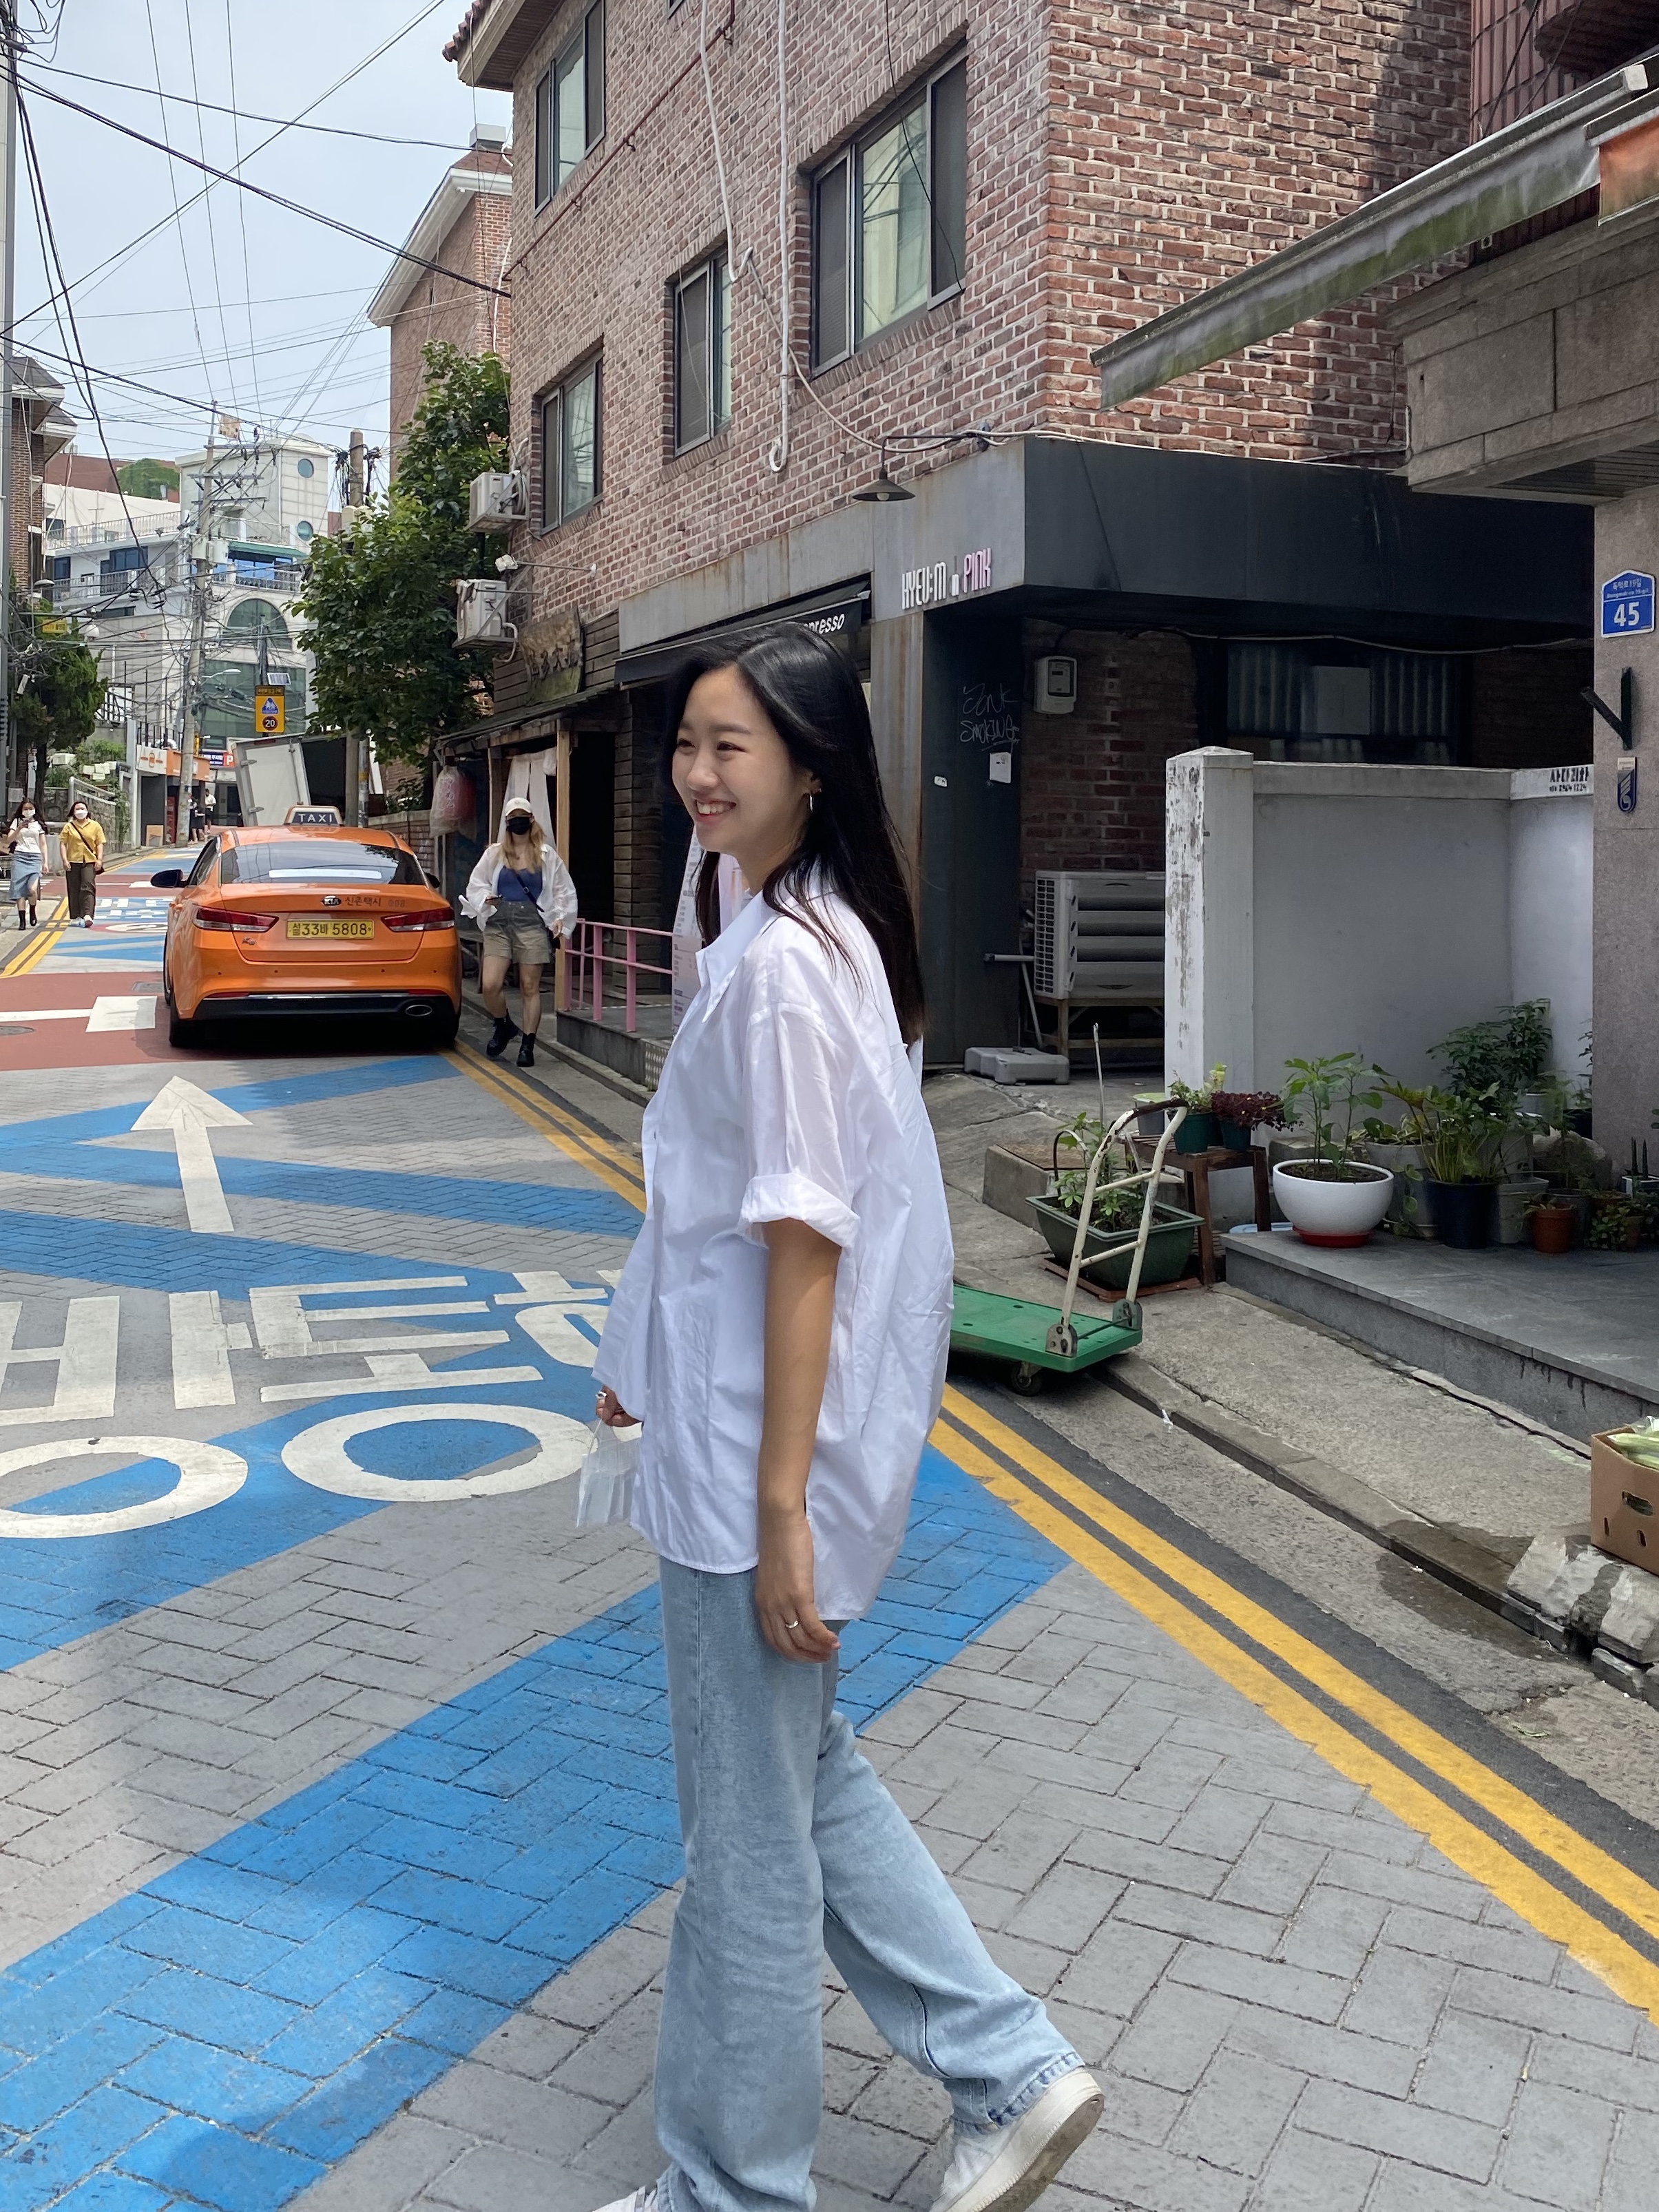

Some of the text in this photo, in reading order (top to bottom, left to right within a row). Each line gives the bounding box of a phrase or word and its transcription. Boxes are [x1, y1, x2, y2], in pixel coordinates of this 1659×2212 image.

[963, 547, 992, 593] PINK
[1614, 601, 1640, 627] 45
[265, 719, 275, 728] 20
[298, 813, 333, 823] TAXI
[324, 897, 340, 906] KIA
[345, 897, 382, 907] 신촌택시
[333, 923, 367, 936] 5808
